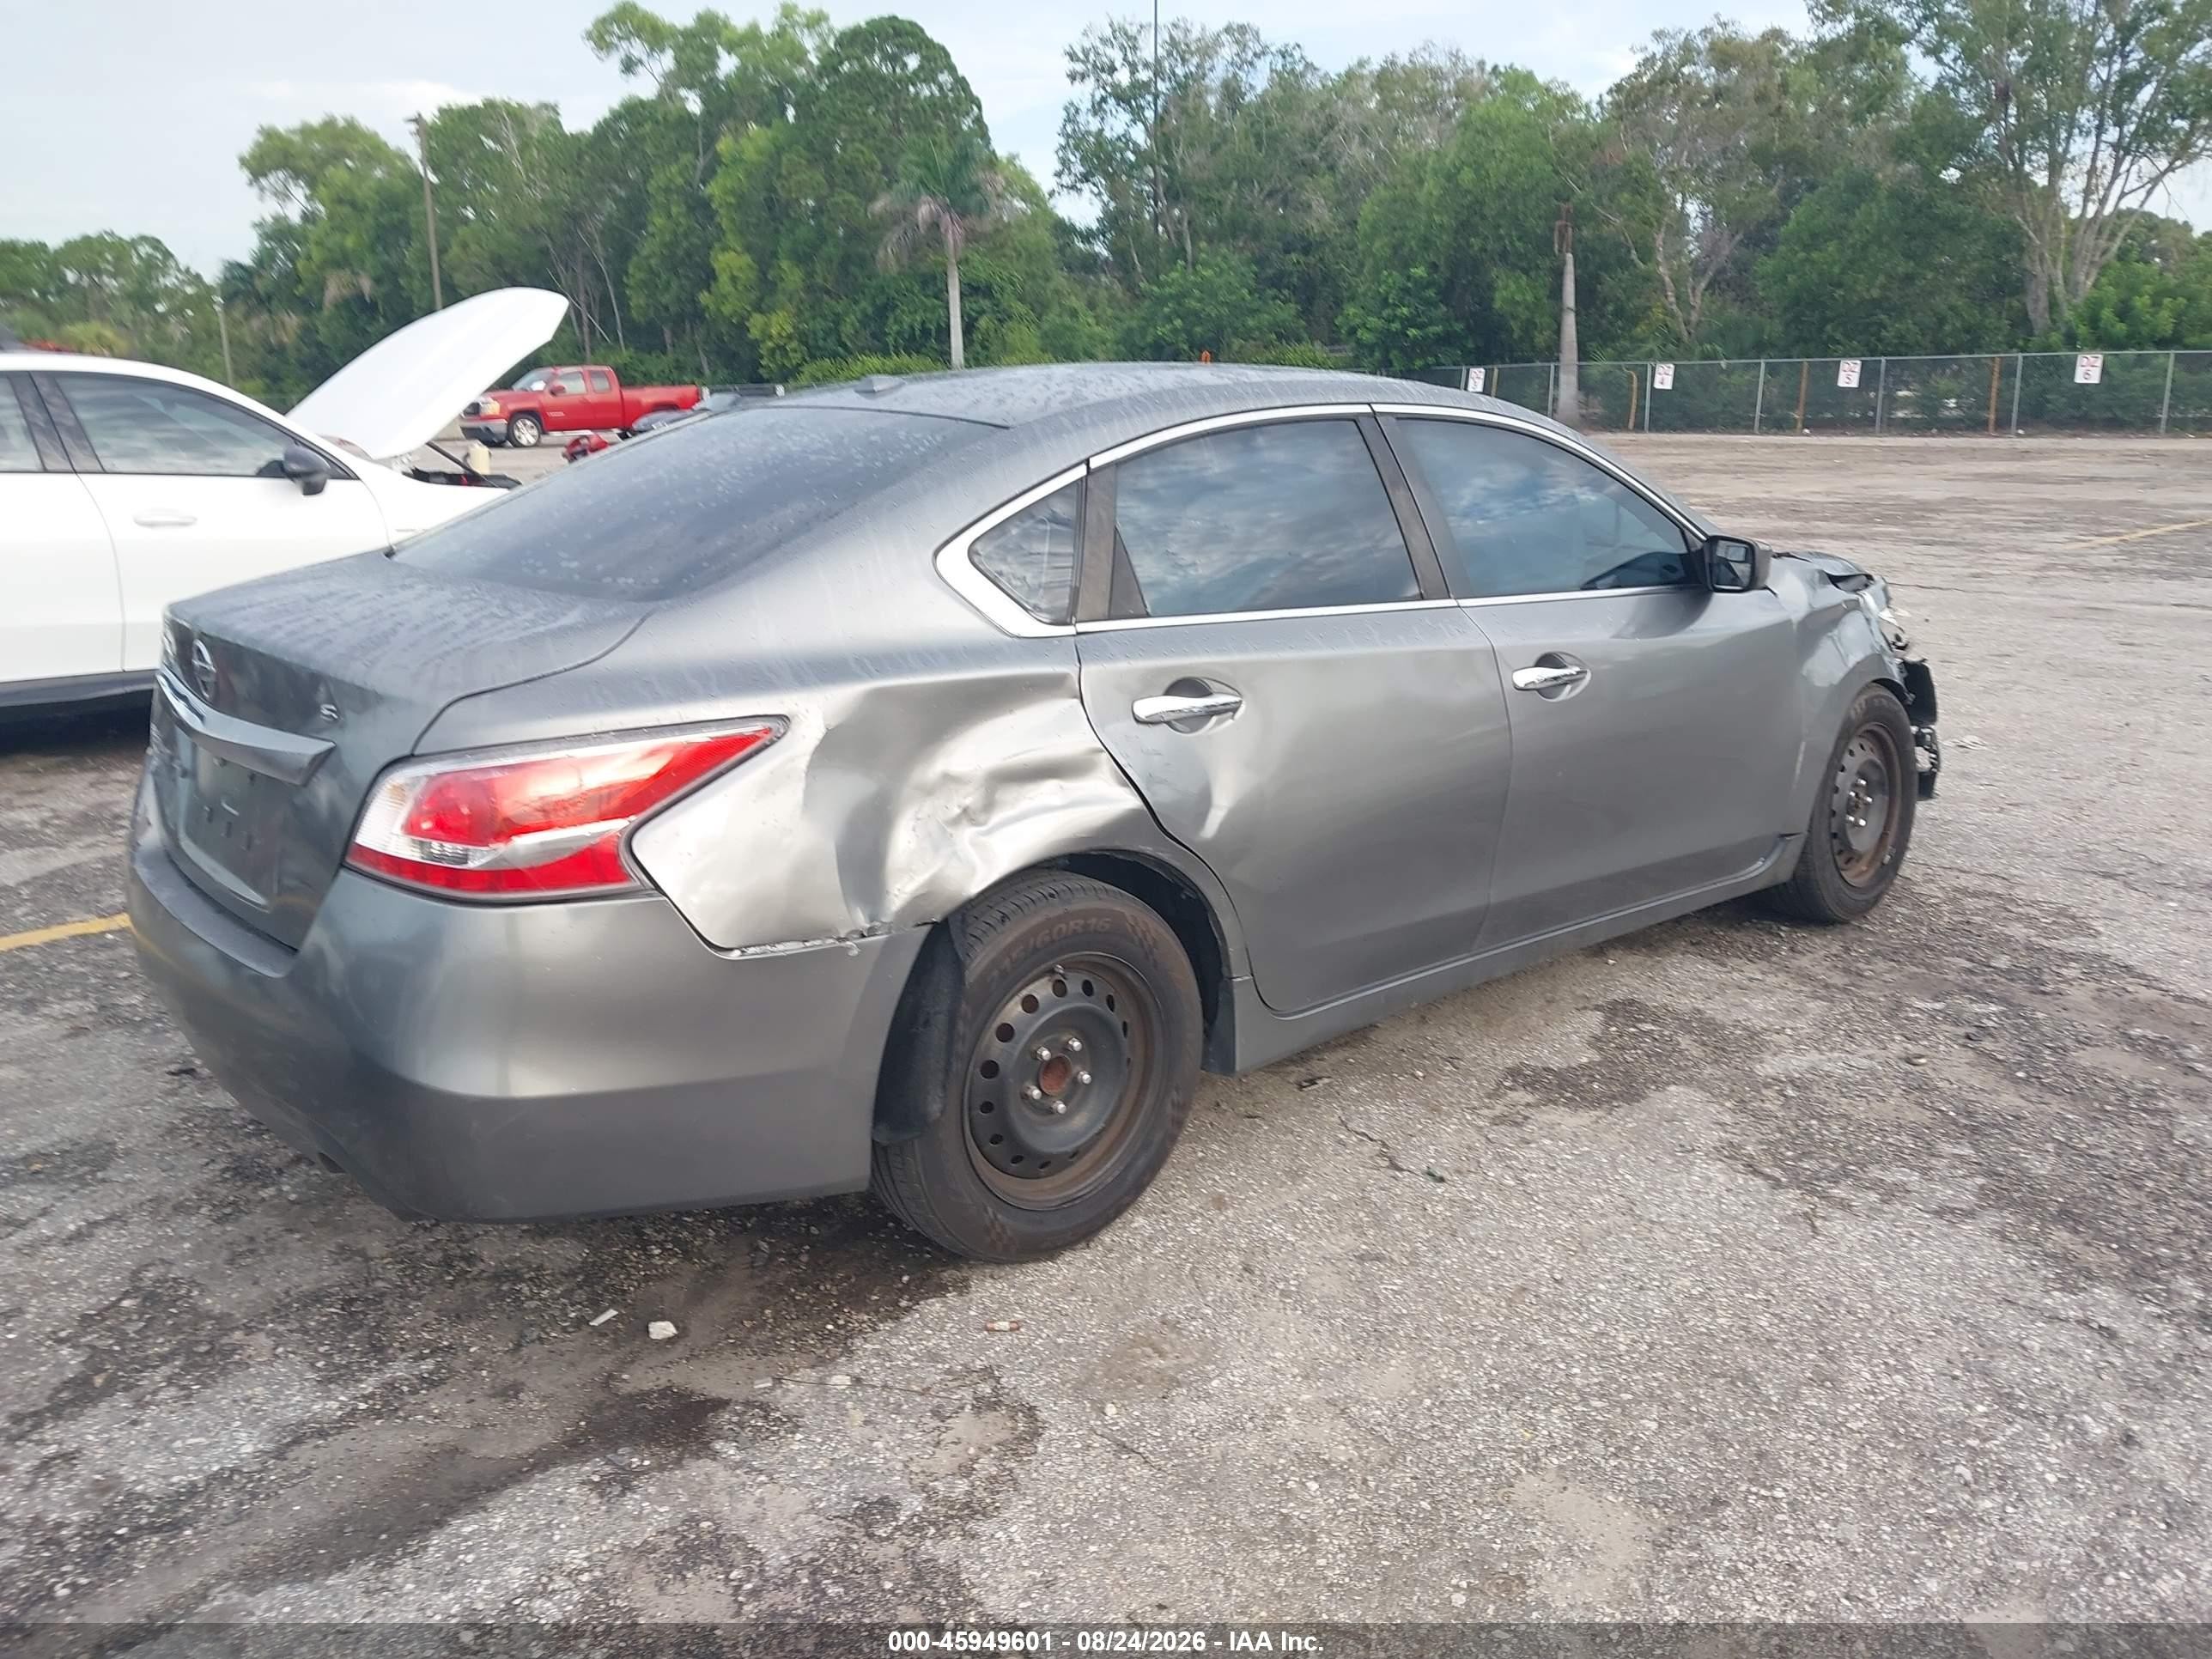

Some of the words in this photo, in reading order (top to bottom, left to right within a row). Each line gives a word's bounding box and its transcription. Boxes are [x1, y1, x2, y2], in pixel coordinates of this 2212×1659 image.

[1843, 361, 1860, 373] DZ
[2081, 355, 2100, 368] DZ
[1657, 365, 1673, 376] DZ
[2082, 369, 2092, 380] 6
[320, 704, 338, 721] S
